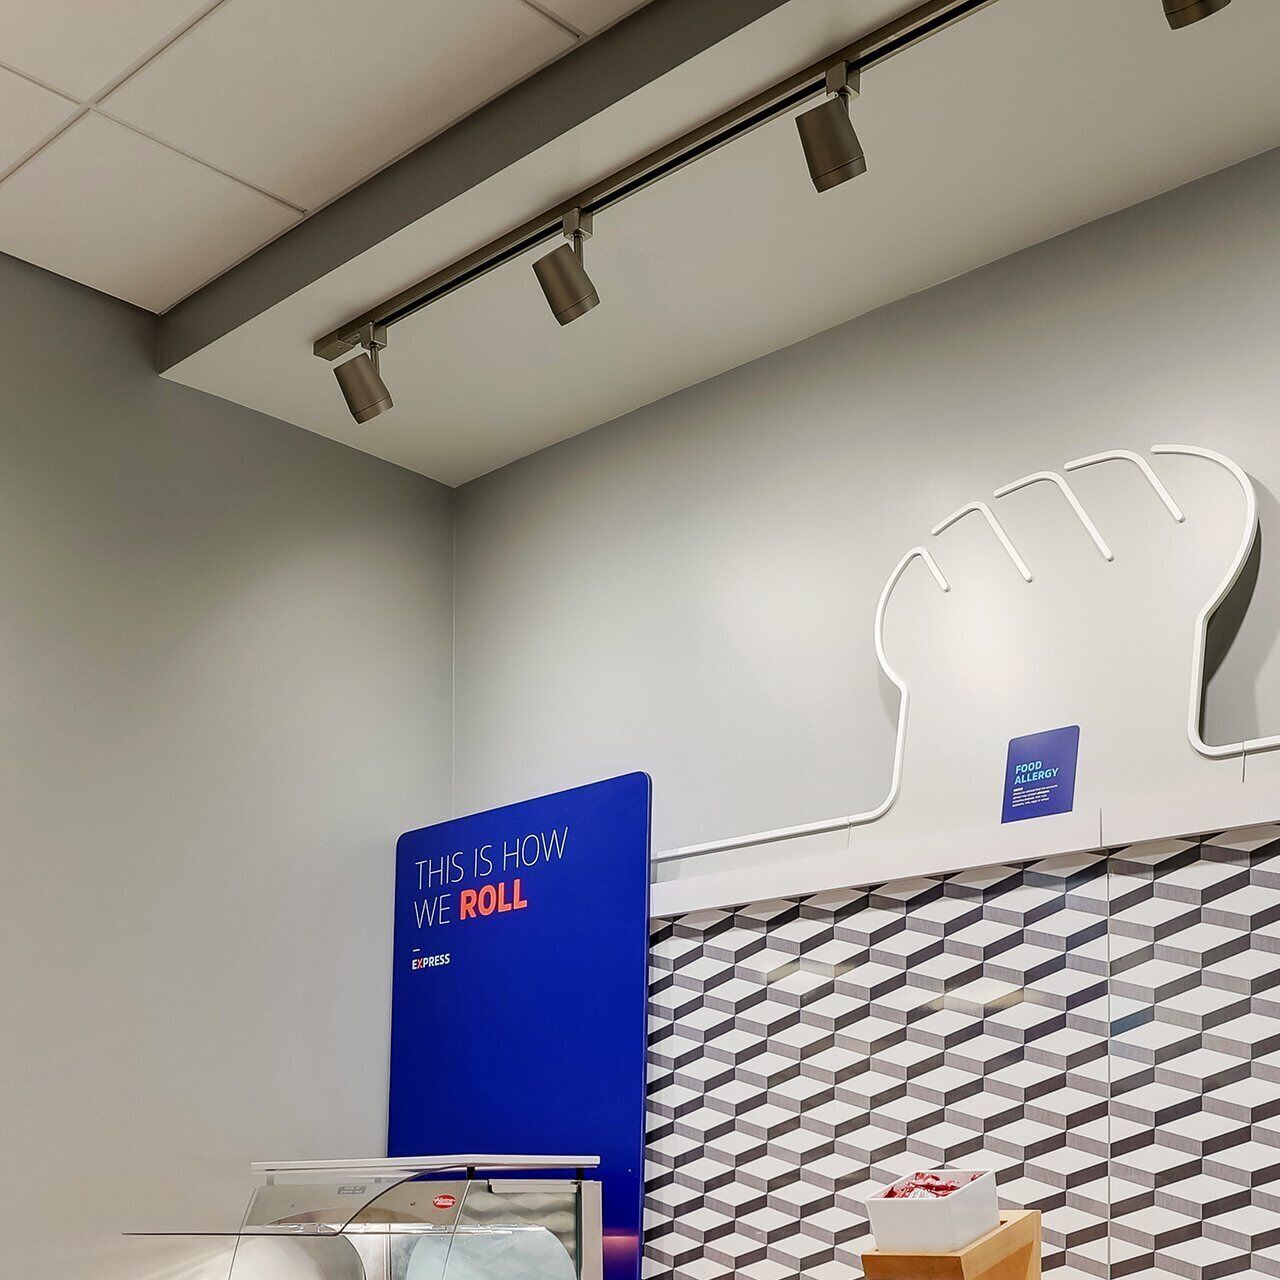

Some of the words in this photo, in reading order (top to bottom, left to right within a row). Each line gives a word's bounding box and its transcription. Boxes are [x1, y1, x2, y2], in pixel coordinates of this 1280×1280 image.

[1016, 761, 1042, 774] FOOD
[1013, 768, 1059, 785] ALLERGY
[415, 851, 465, 890] THIS
[474, 844, 494, 878] IS
[502, 826, 569, 871] HOW
[413, 893, 451, 929] WE
[459, 878, 528, 920] ROLL
[411, 953, 451, 970] EXPRESS
